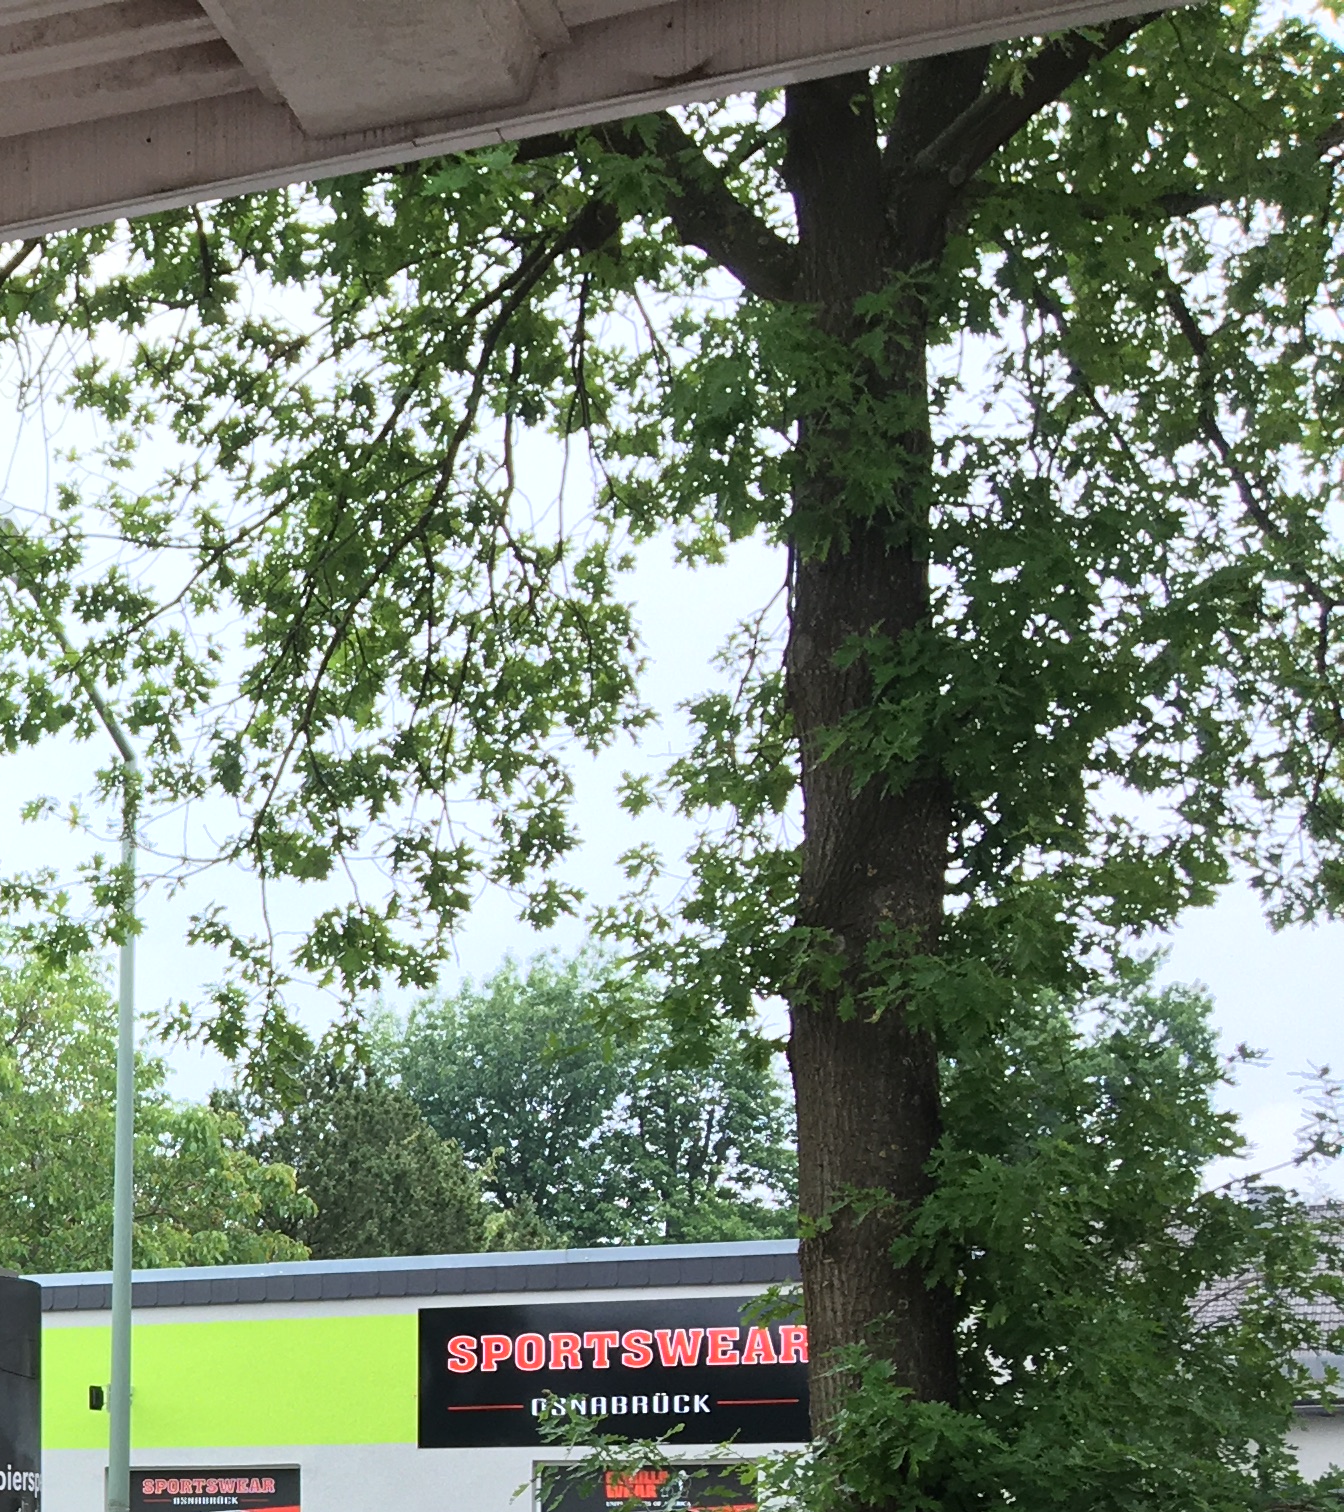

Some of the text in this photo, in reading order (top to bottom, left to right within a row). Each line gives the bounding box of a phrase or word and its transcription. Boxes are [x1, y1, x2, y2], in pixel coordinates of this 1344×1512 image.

[447, 1325, 810, 1374] SPORTSWEAR
[531, 1392, 711, 1417] OSNABRÜCK
[142, 1477, 276, 1495] SPORTSWEAR
